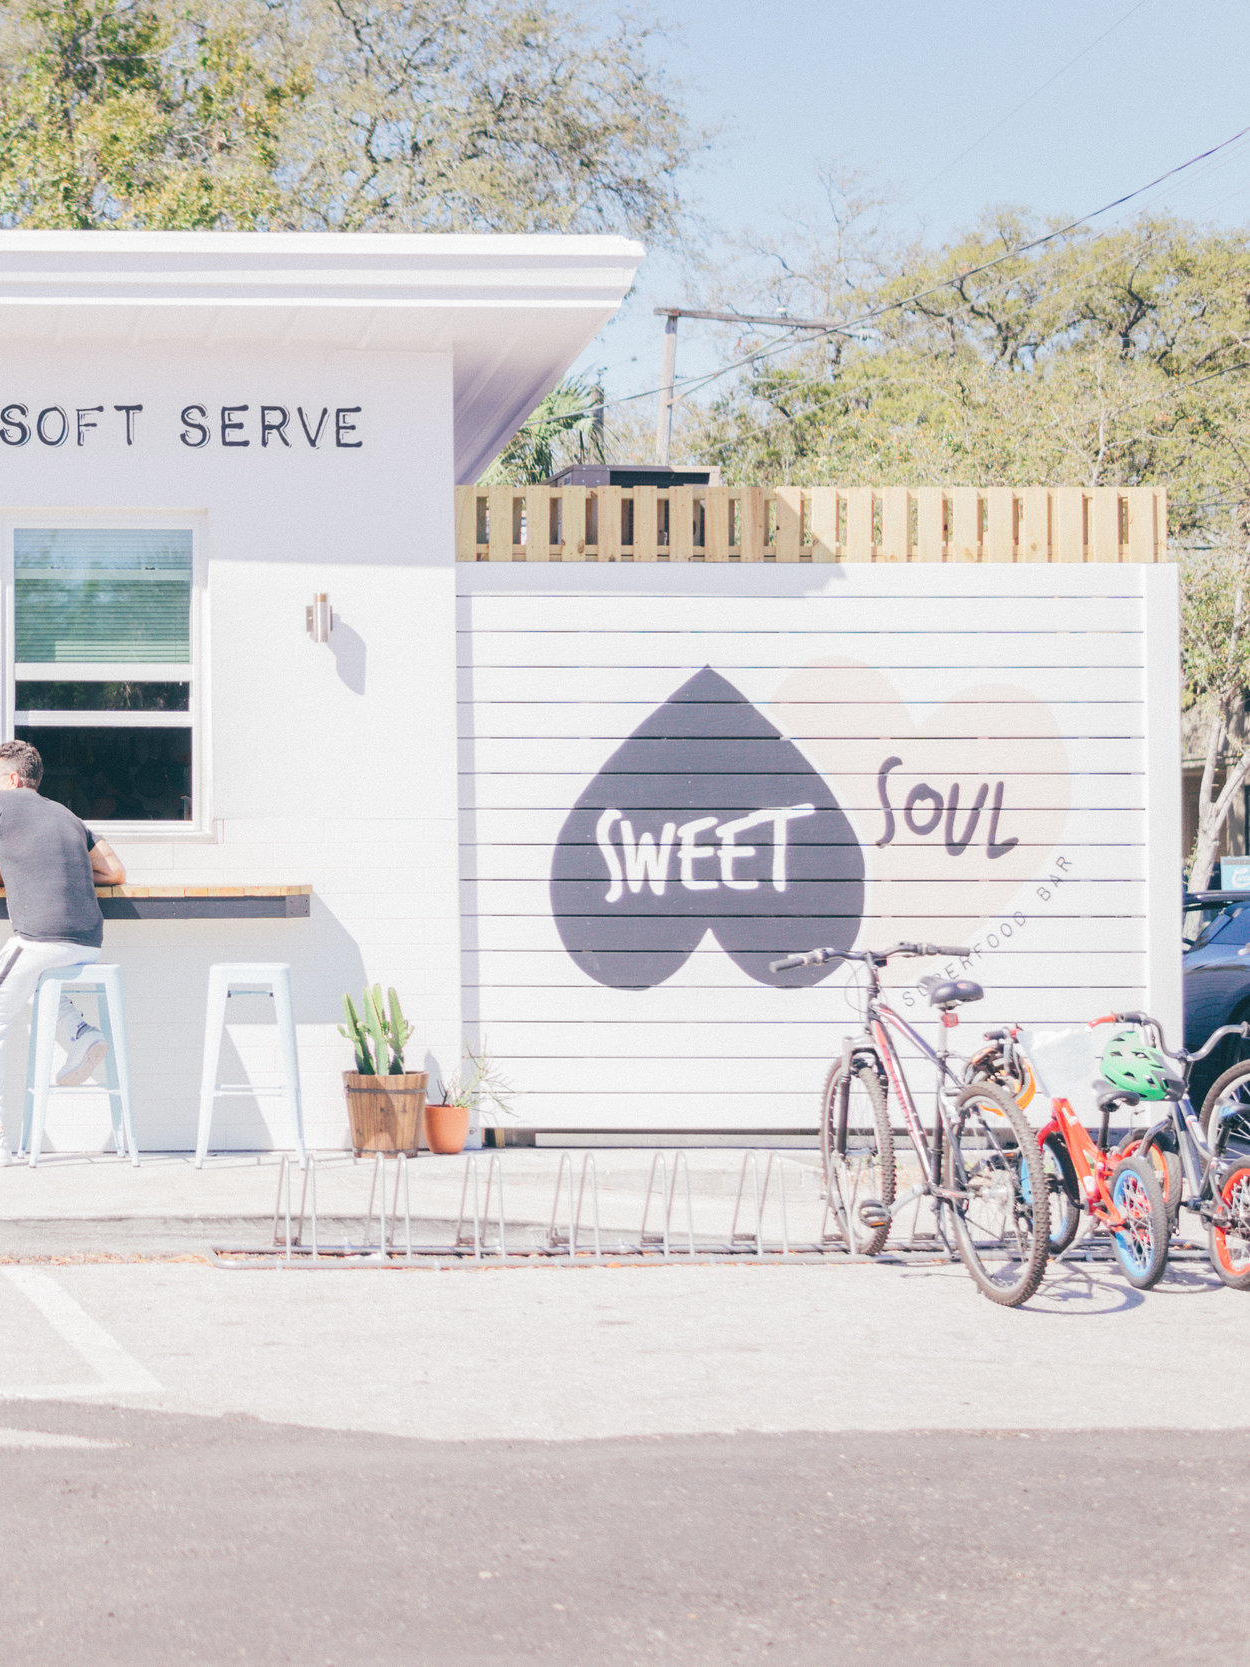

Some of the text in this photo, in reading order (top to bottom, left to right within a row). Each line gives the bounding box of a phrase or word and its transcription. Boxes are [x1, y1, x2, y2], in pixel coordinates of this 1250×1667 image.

[0, 403, 143, 448] SOFT
[180, 404, 363, 448] SERVE
[596, 756, 1019, 902] SWEET SOUL
[1036, 856, 1072, 902] BAR
